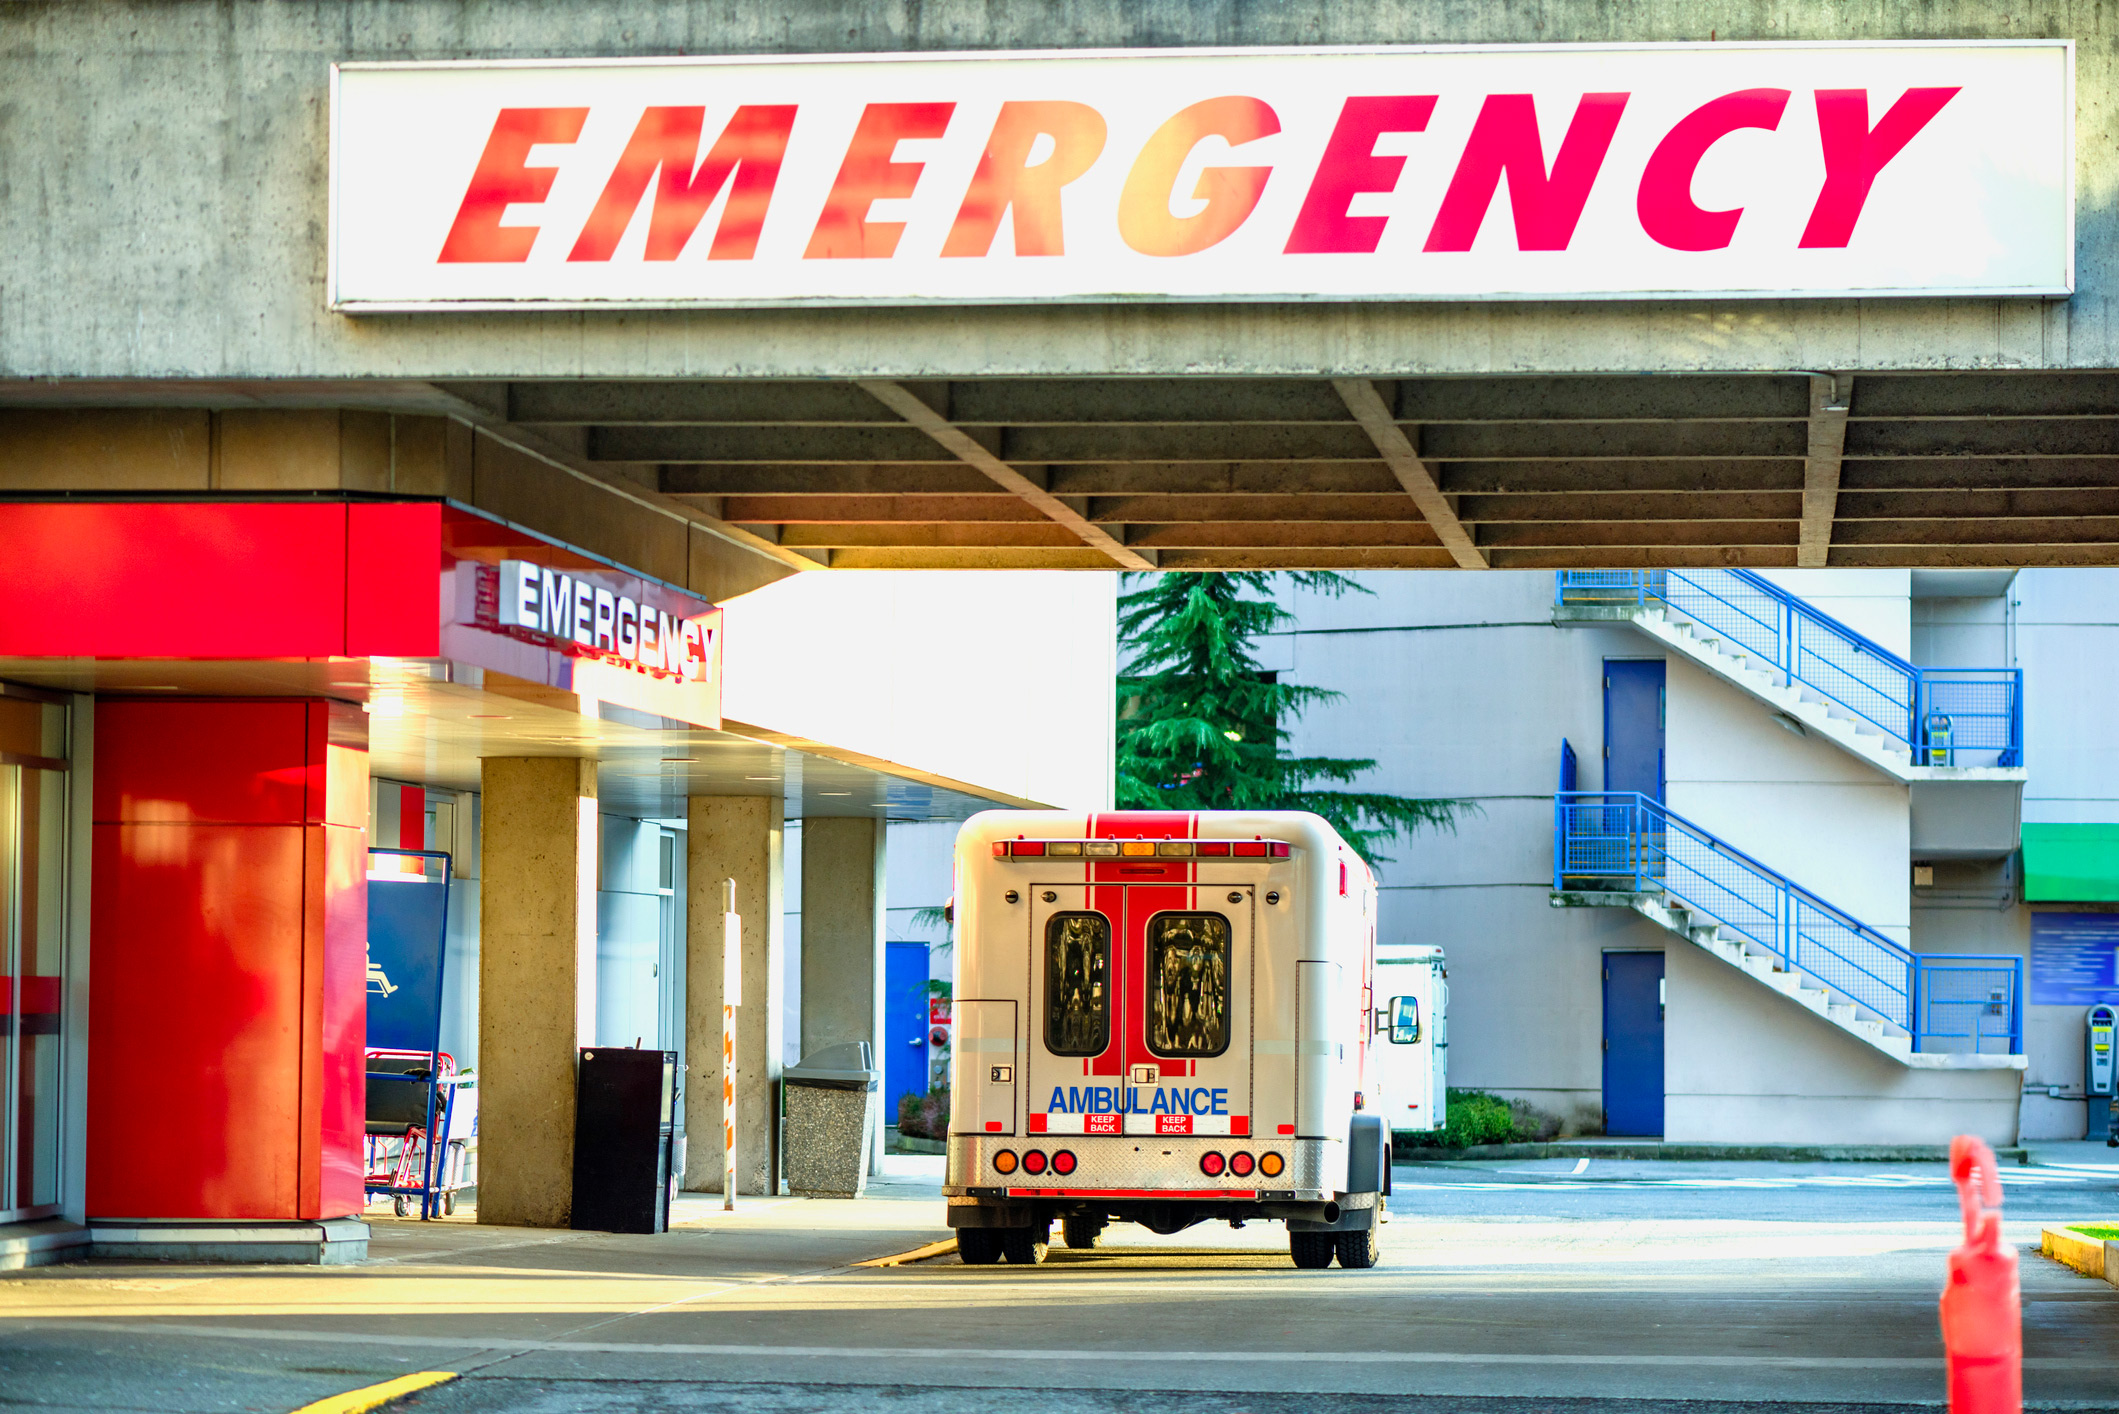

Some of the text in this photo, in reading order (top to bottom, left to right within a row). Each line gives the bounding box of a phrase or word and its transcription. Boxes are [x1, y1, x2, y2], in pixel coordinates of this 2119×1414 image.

[437, 86, 1961, 264] EMERGENCY
[517, 560, 718, 683] EMERGENCY
[1047, 1086, 1229, 1115] AMBULANCE
[1090, 1115, 1115, 1123] KEEP
[1162, 1116, 1187, 1124] KEEP
[1090, 1124, 1115, 1132] BACK
[1162, 1124, 1187, 1133] BACK
